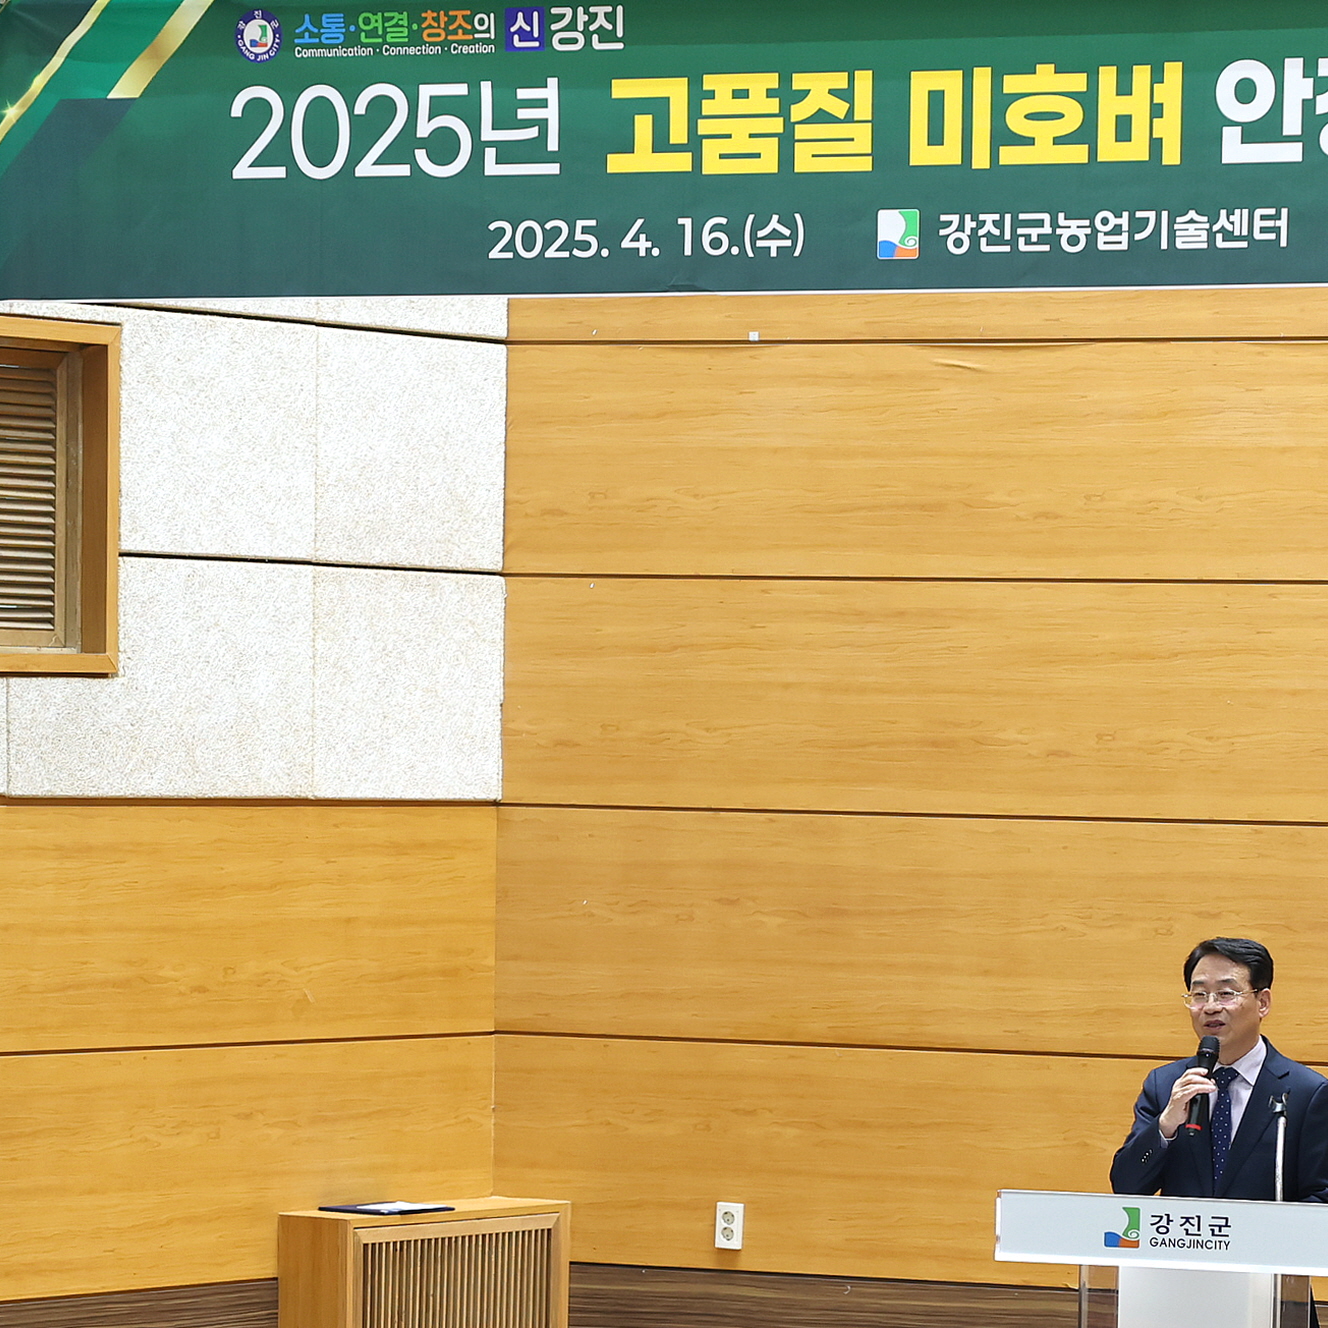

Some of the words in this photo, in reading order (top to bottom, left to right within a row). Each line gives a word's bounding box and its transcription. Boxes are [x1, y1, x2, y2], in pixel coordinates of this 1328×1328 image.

[294, 45, 374, 58] Communication
[382, 44, 442, 56] Connection
[450, 42, 495, 54] Creation
[510, 11, 540, 48] 신
[550, 5, 625, 51] 강진
[230, 77, 561, 180] 2025년
[606, 69, 873, 175] 고품질
[909, 61, 1184, 169] 미호벼
[487, 218, 610, 259] 2025.
[621, 218, 660, 258] 4.
[677, 212, 805, 258] 16.(수)
[938, 207, 1290, 256] 강진군농업기술센터
[1149, 1237, 1231, 1251] GANGJINCITY
